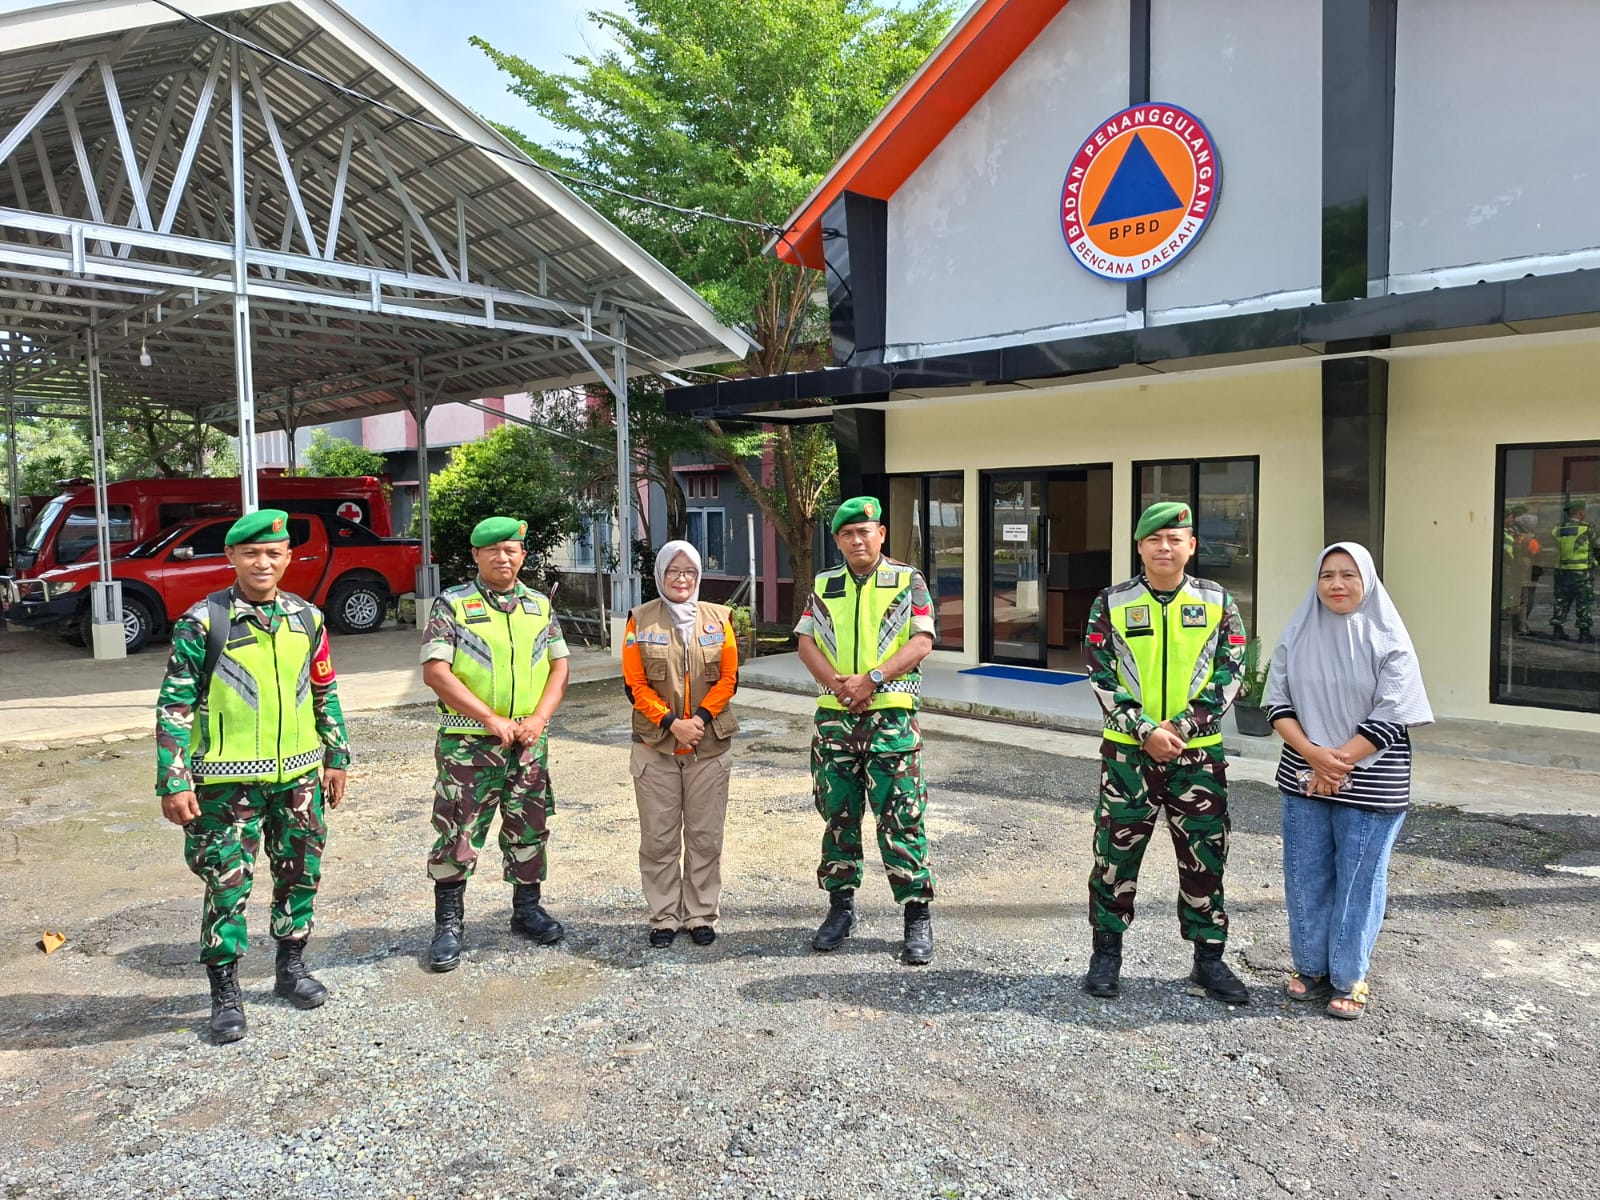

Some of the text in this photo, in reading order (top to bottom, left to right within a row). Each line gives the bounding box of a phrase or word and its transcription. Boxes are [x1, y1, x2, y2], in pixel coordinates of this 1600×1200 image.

[1065, 109, 1212, 238] BADAN PENANGGULANGAN
[1076, 221, 1196, 274] BENCANA DAERAH
[1109, 219, 1159, 240] BPBD
